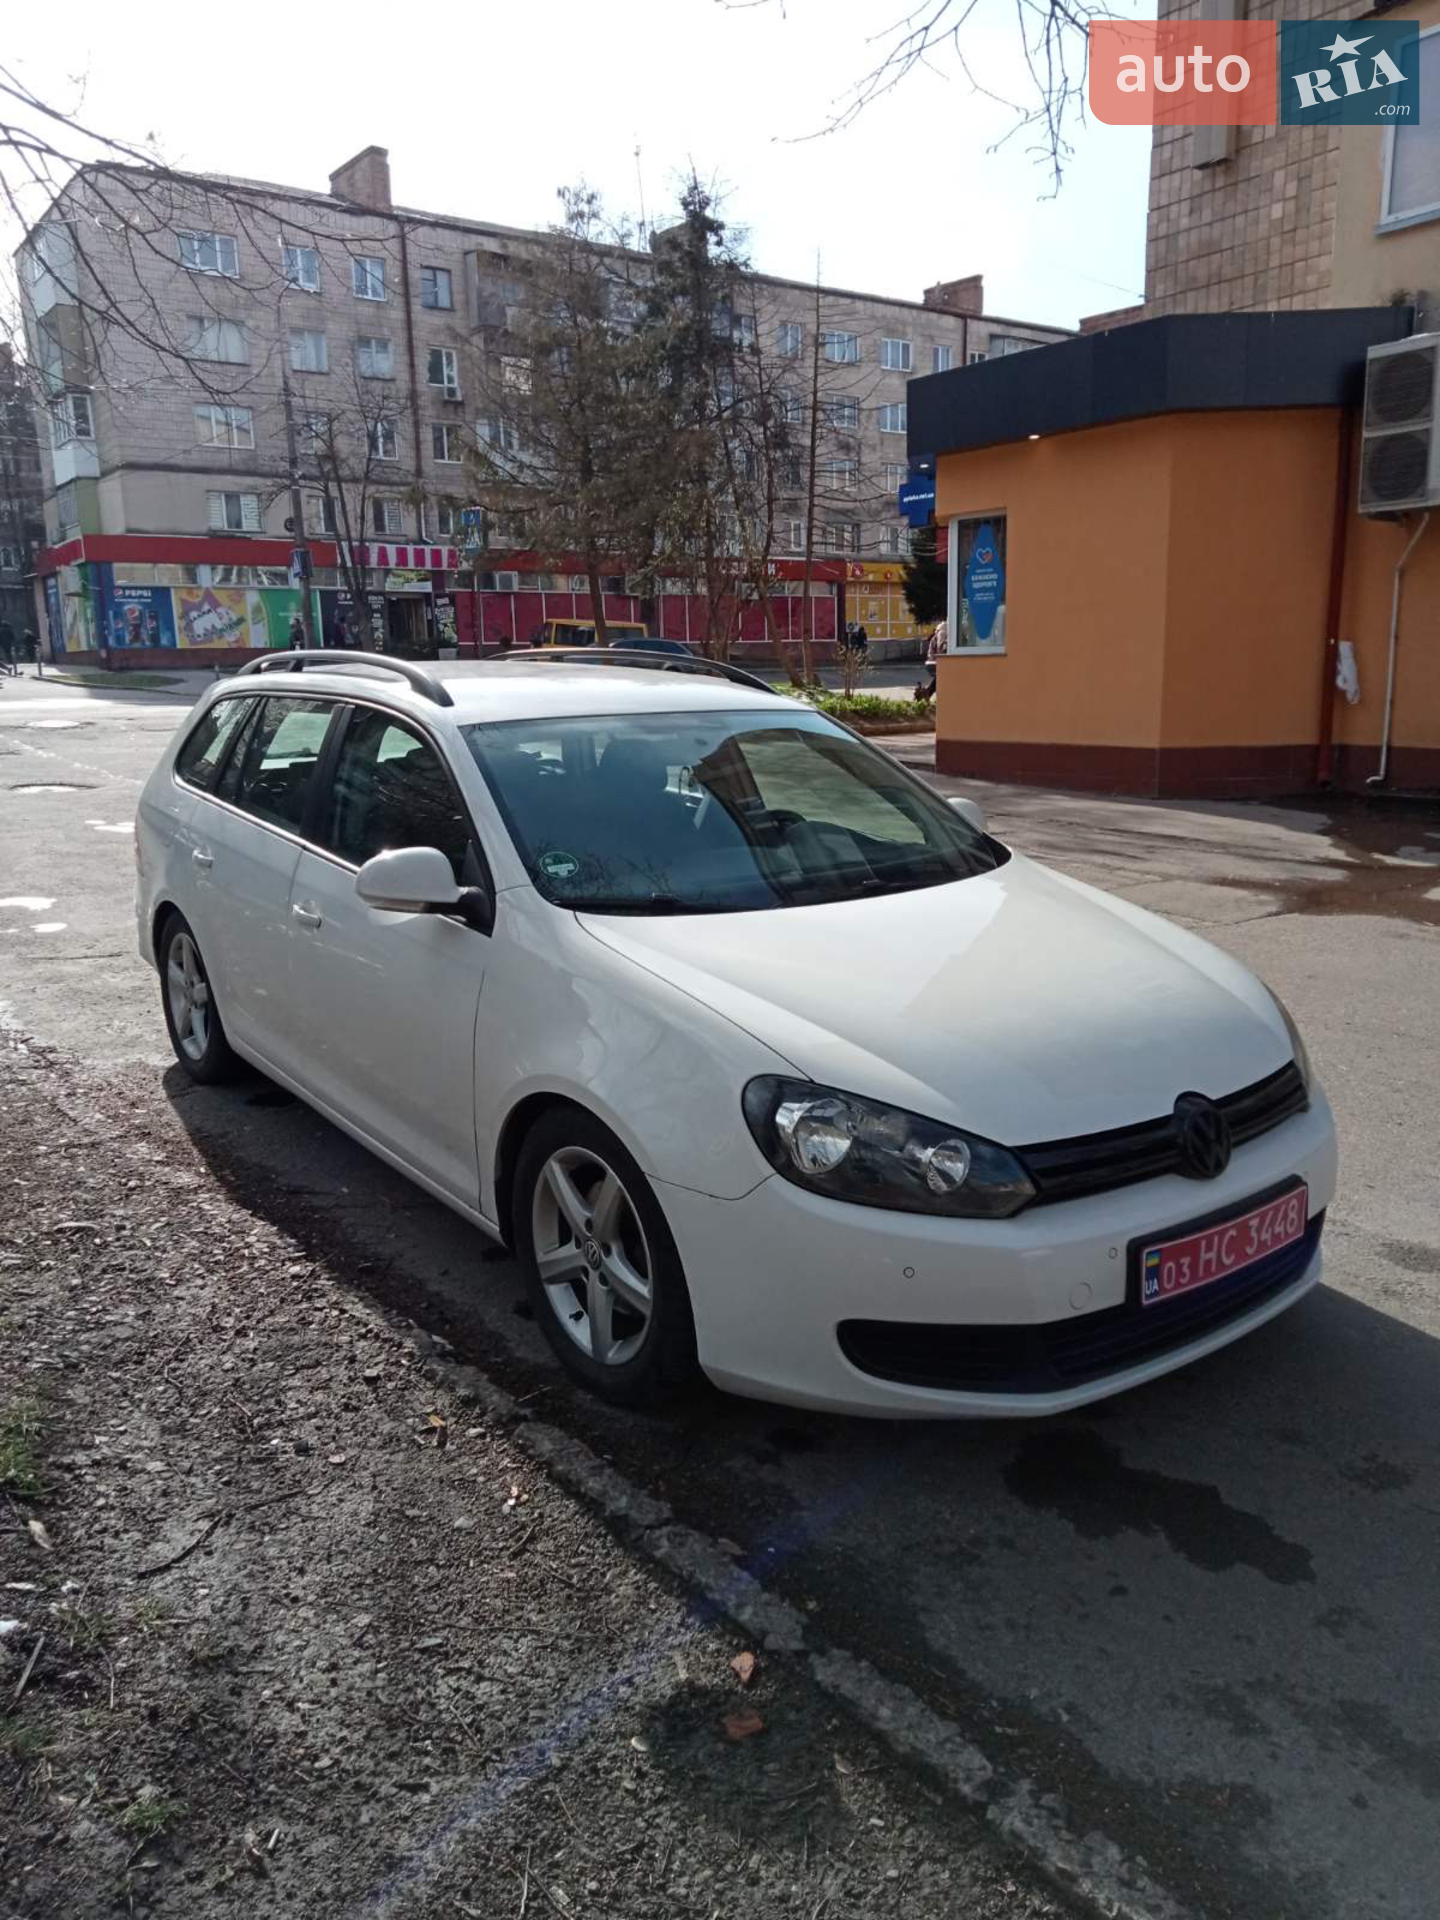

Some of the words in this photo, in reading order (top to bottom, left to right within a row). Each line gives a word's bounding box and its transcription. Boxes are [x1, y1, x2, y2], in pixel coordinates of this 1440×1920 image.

[1145, 1279, 1159, 1294] UA
[1163, 1257, 1191, 1289] 03
[1199, 1229, 1237, 1277] HC
[1246, 1199, 1299, 1256] 3448
